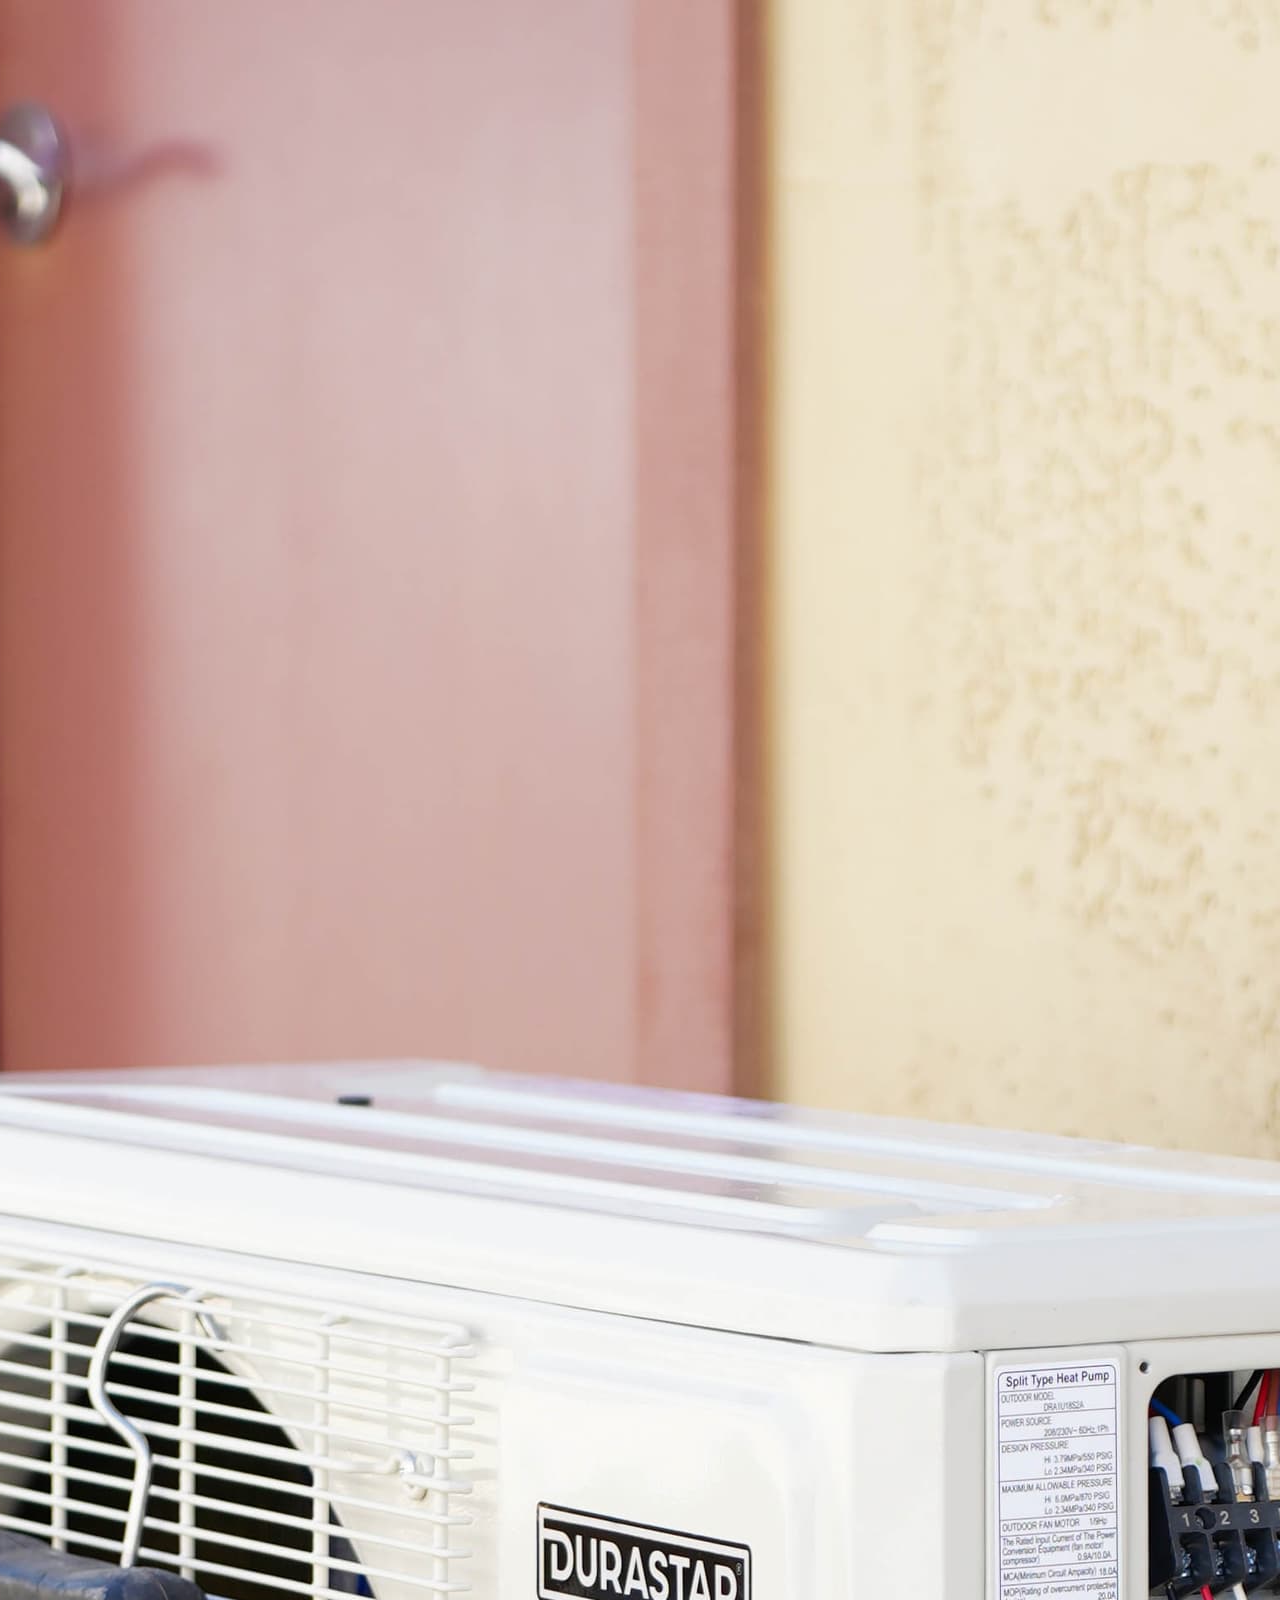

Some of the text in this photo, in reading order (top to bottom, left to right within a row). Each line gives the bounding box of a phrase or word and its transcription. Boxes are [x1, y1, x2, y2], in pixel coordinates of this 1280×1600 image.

[1006, 1369, 1110, 1389] Split Type Heat Pump
[1001, 1391, 1055, 1403] OUTDOOR MODEL
[1001, 1416, 1053, 1428] POWER SOURCE
[1001, 1440, 1069, 1453] DESIGN PRESSURE
[1002, 1477, 1113, 1494] MAXIMUM ALLOWABLE PRESSURE
[1002, 1518, 1080, 1532] OUTDOOR FAN MOTOR
[1182, 1513, 1190, 1527] 1
[1220, 1510, 1231, 1525] 2
[1250, 1509, 1260, 1523] 3
